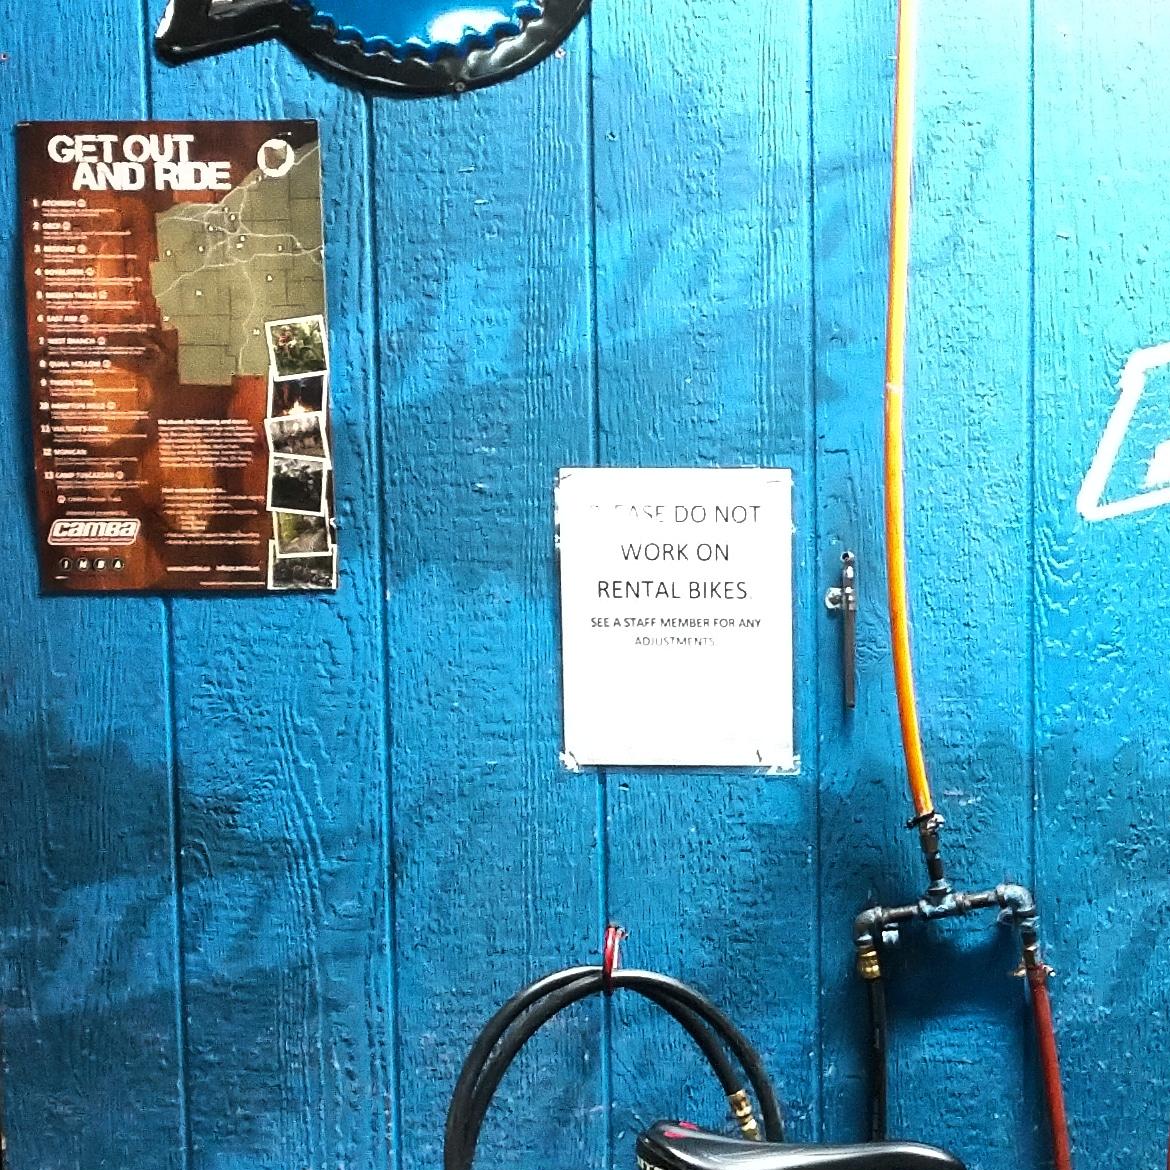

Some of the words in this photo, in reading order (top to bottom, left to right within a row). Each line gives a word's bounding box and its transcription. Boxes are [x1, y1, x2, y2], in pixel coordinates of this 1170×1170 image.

[47, 134, 119, 163] GET
[123, 134, 194, 163] OUT
[73, 162, 145, 191] AND
[155, 162, 231, 190] RIDE
[675, 505, 706, 524] DO
[715, 505, 761, 524] NOT
[621, 543, 689, 561] WORK
[697, 543, 729, 561] ON
[598, 580, 680, 599] RENTAL
[591, 617, 609, 628] SEE
[613, 617, 621, 628] A
[624, 617, 656, 628] STAFF
[661, 617, 709, 628] MEMBER
[713, 617, 735, 628] FOR
[739, 617, 761, 628] ANY
